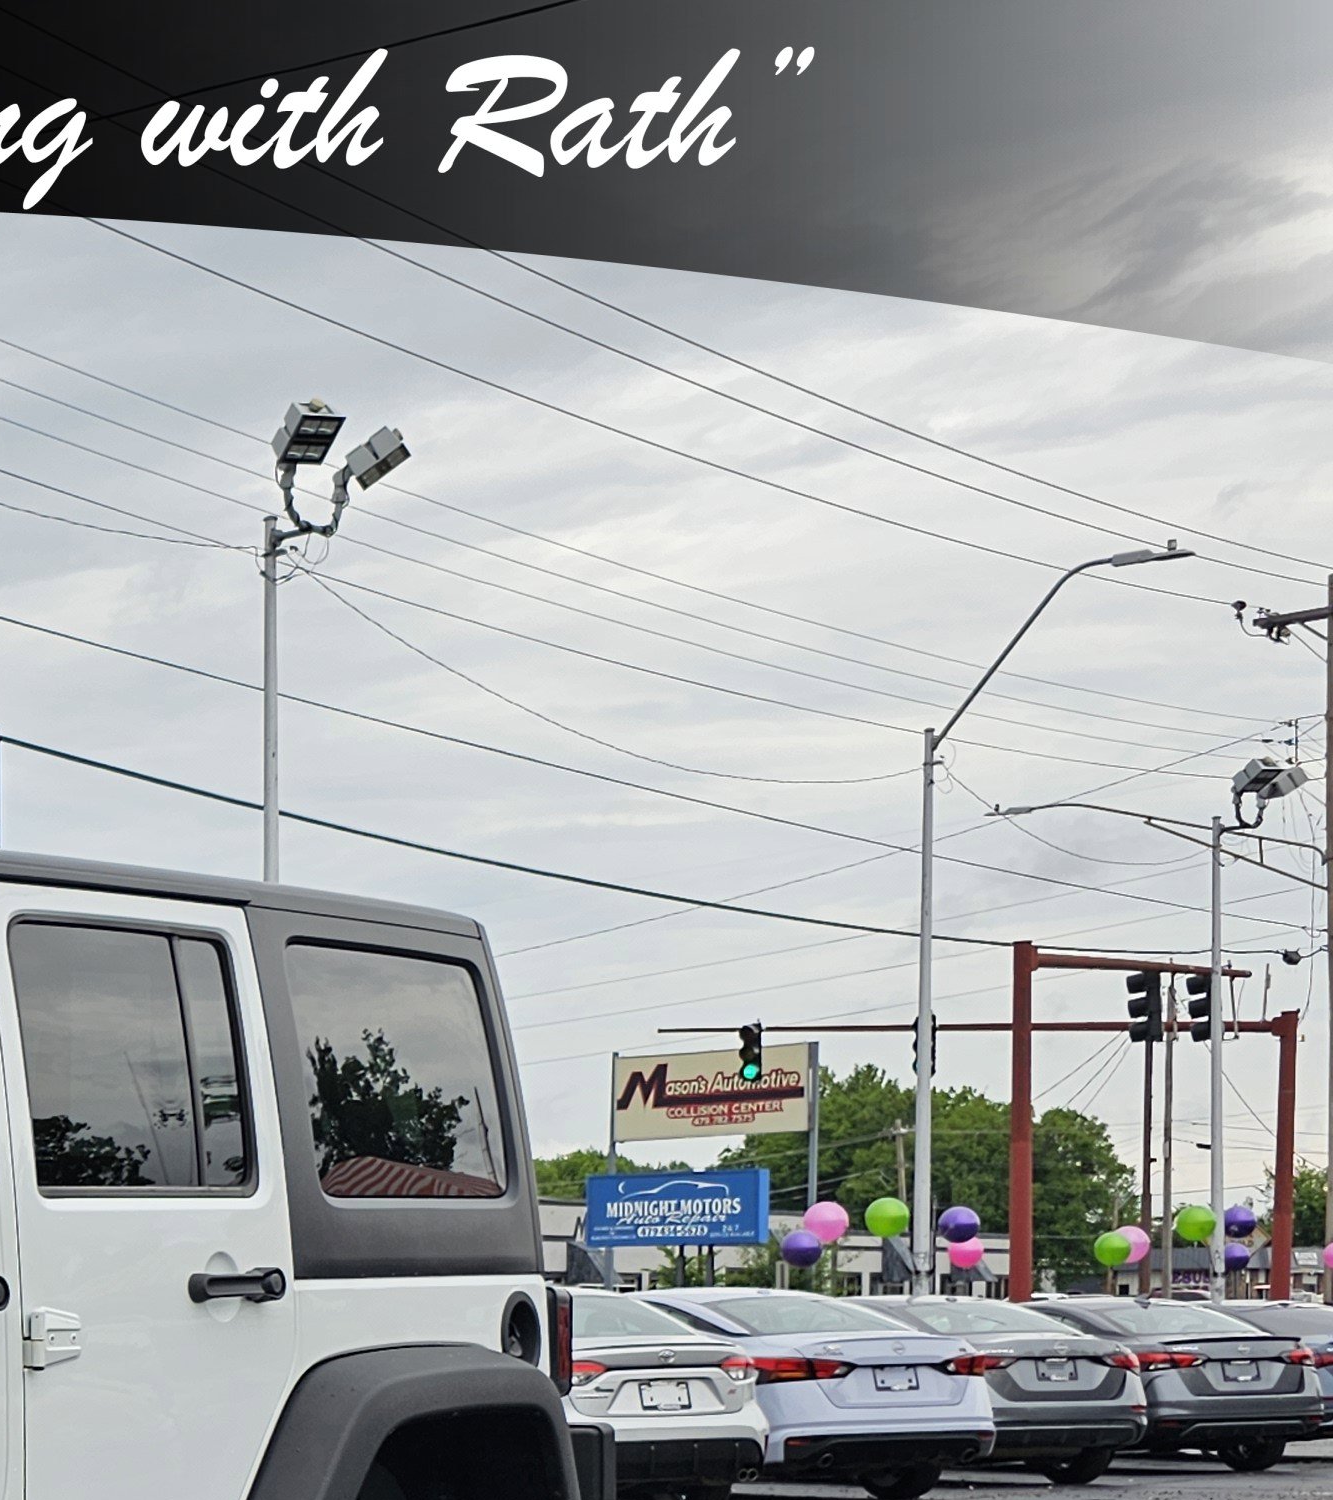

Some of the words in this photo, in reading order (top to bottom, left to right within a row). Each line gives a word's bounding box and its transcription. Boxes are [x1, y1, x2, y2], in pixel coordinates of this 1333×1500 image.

[667, 1105, 728, 1118] COLLISION
[731, 1100, 781, 1113] CENTER
[606, 1199, 679, 1218] MIDNIGHT
[681, 1197, 742, 1215] MOTORS
[616, 1213, 661, 1226] Auto
[664, 1212, 727, 1229] Repair
